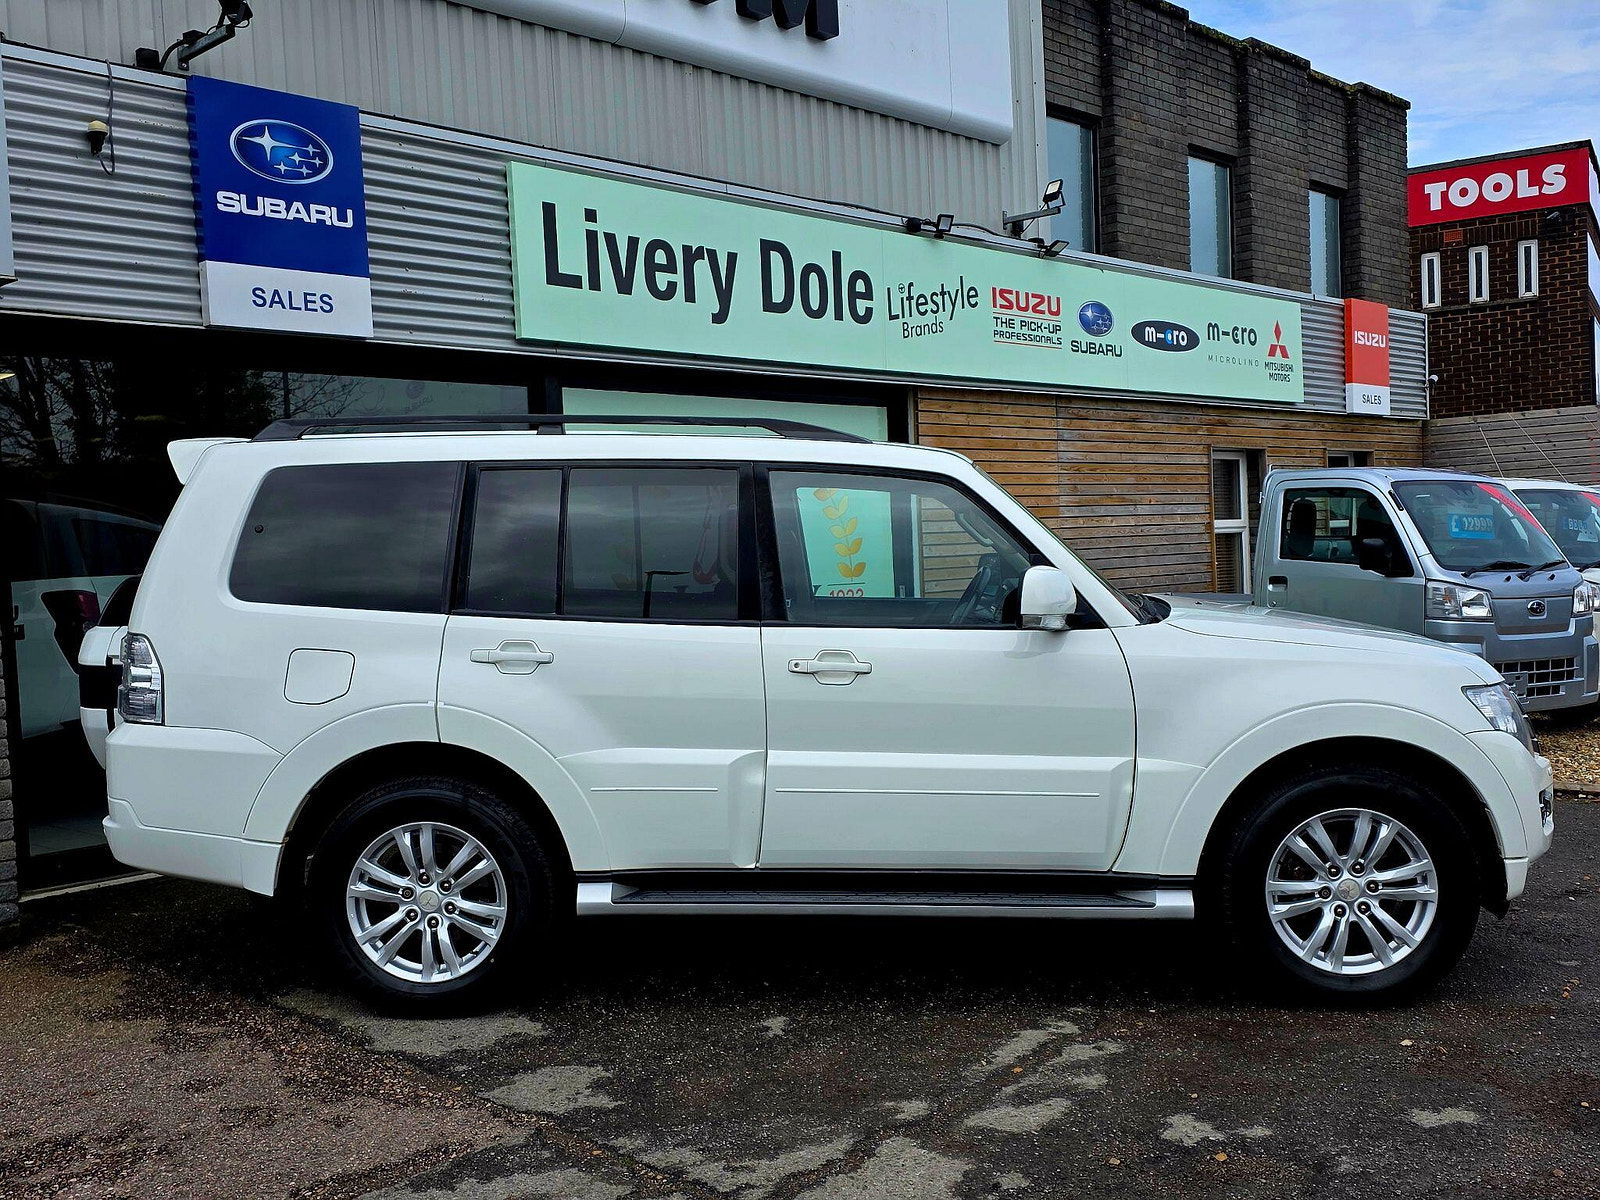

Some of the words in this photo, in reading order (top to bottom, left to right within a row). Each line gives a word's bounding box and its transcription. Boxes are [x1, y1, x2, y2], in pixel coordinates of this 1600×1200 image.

[1424, 163, 1567, 211] TOOLS
[215, 190, 354, 230] SUBARU
[541, 201, 738, 325] Livery
[759, 237, 874, 325] Dole
[251, 286, 335, 315] SALES
[887, 275, 979, 321] Lifestyle
[991, 286, 1061, 317] ISUZU
[902, 315, 944, 339] Brands
[993, 316, 1015, 329] THE
[1020, 319, 1062, 335] PICK-UP
[993, 329, 1062, 345] PROFESSIONALS
[1354, 330, 1386, 348] ISUZU
[1070, 339, 1123, 358] SUBARU
[1207, 354, 1260, 367] MICROLINO
[1264, 361, 1294, 373] MITSUBISHI
[1268, 372, 1291, 383] MOTORS
[1362, 393, 1382, 406] SALES
